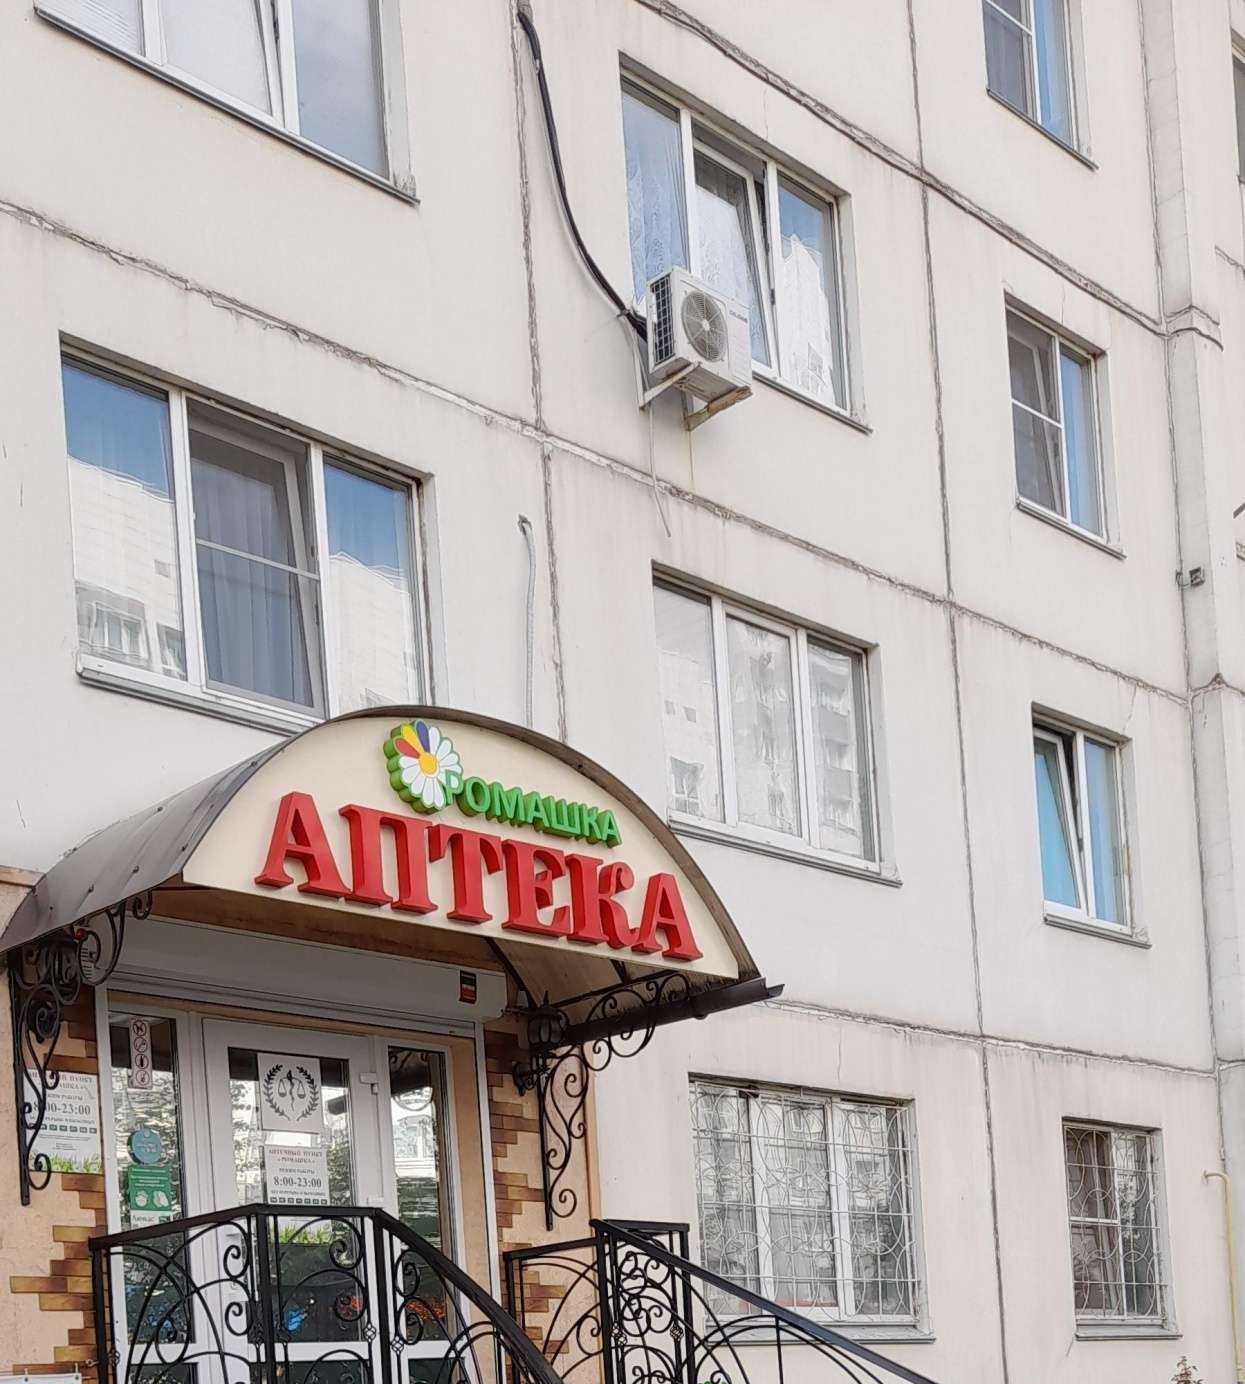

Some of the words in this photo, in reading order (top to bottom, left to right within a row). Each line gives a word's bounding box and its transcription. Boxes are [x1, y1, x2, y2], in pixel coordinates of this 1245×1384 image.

[445, 768, 622, 848] РОМАШКА
[254, 791, 704, 961] АПТЕКА
[273, 1176, 322, 1188] 8:00-23:00
